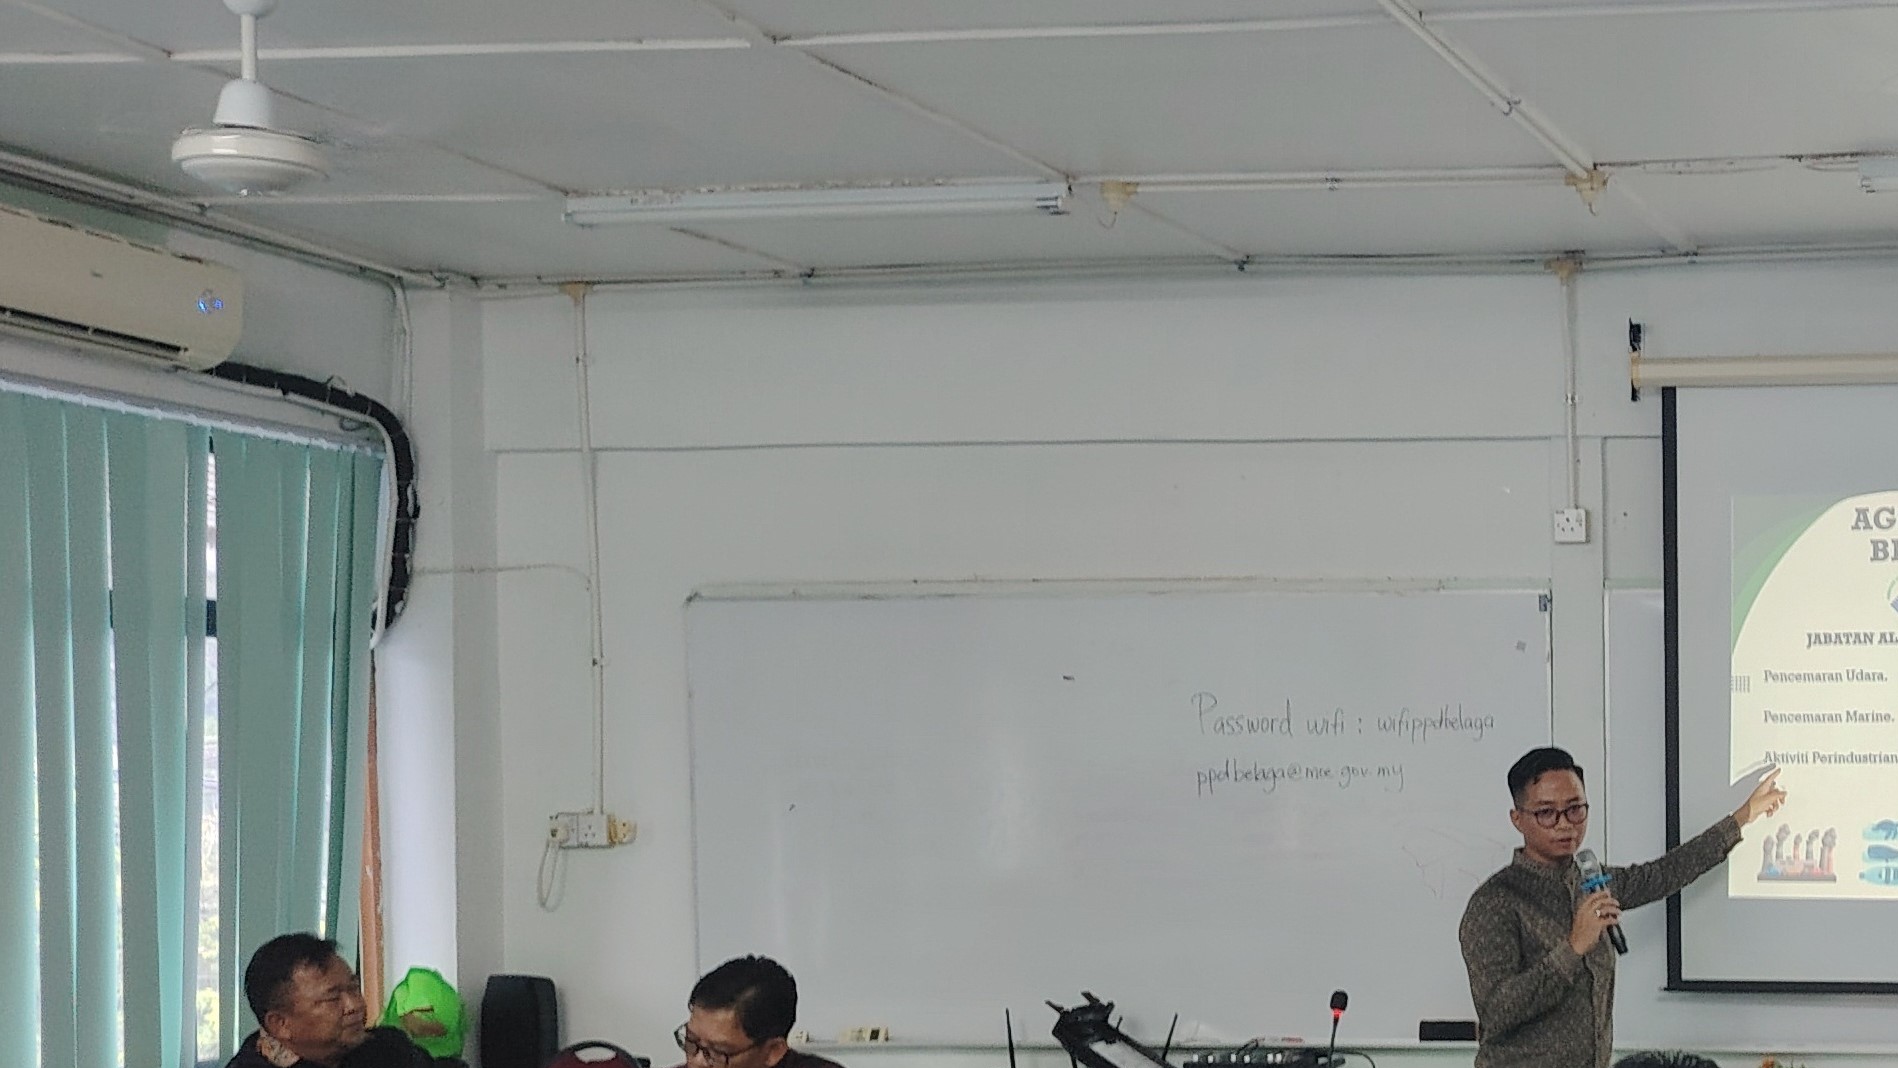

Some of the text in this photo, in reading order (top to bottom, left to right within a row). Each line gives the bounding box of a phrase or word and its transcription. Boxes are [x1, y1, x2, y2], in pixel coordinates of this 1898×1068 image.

[1806, 632, 1874, 649] JABATAN
[1763, 669, 1888, 683] Pencemaran Udara.
[1191, 691, 1293, 737] Password
[1307, 708, 1345, 736] wifi
[1763, 709, 1895, 723] Pencemaran Marine.
[1763, 751, 1809, 764] Aktiviti
[1812, 751, 1898, 764] Perindustrian
